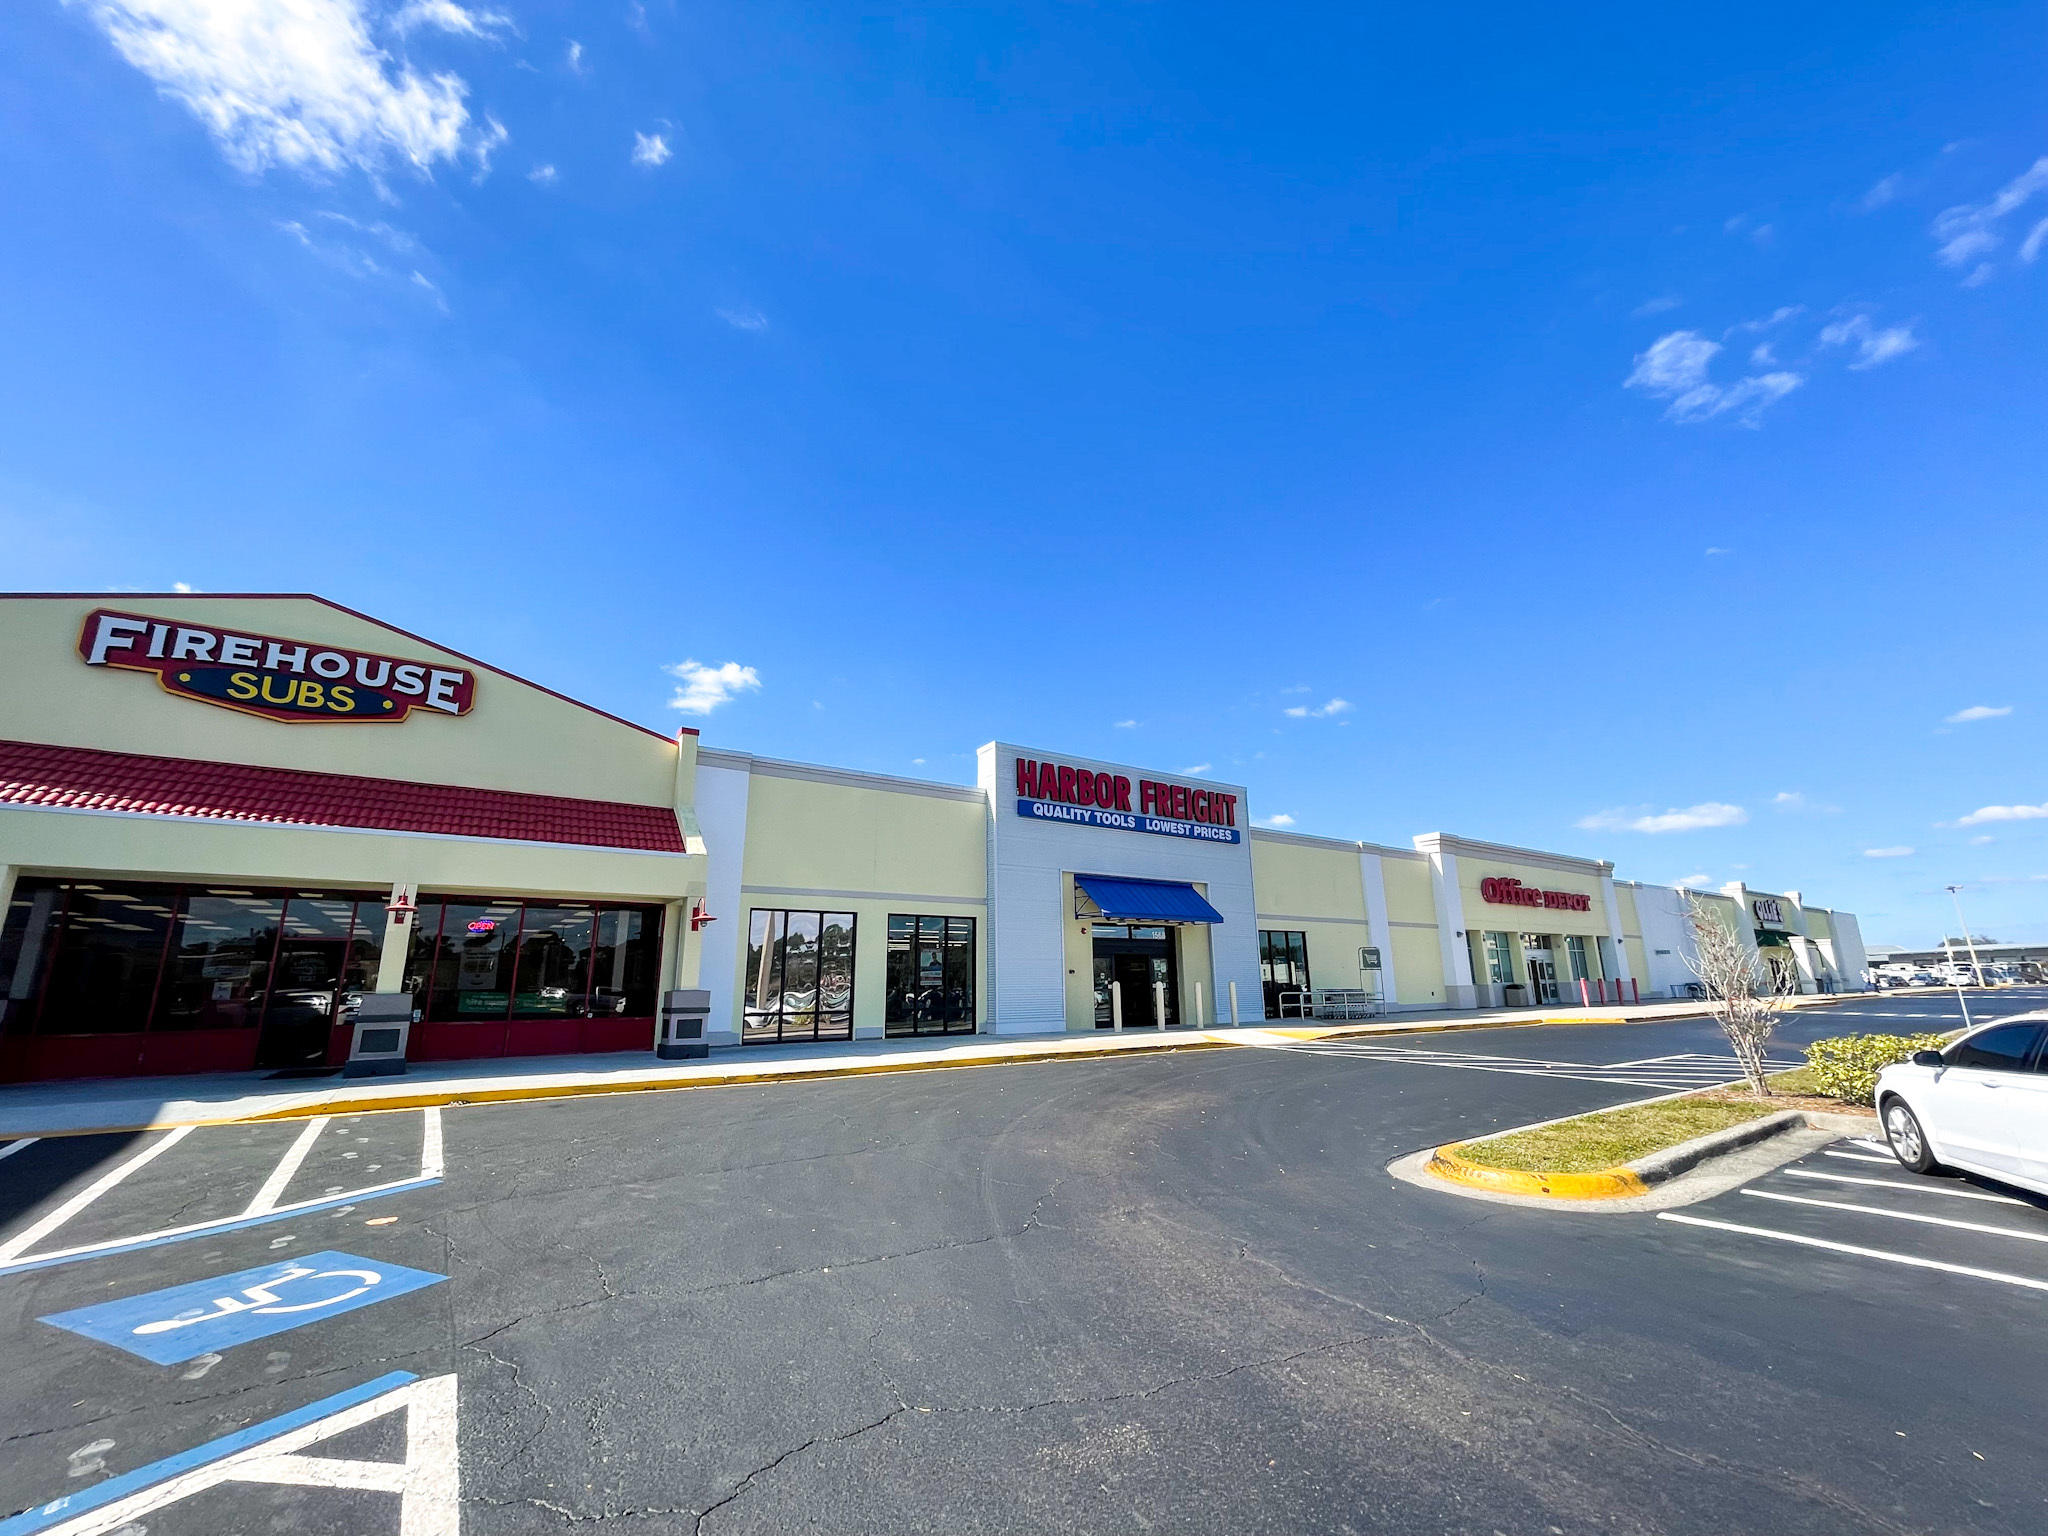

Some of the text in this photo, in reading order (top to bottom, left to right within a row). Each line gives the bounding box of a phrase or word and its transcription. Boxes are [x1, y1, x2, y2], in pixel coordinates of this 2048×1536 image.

[87, 615, 463, 715] FIREHOUSE
[226, 672, 355, 711] SUBS
[1016, 757, 1237, 826] HARBOR FREIGHT
[1033, 802, 1232, 841] QUALITY TOOLS LOWEST PRICES
[1481, 877, 1591, 911] Office DEPOT
[468, 921, 495, 930] OPEN
